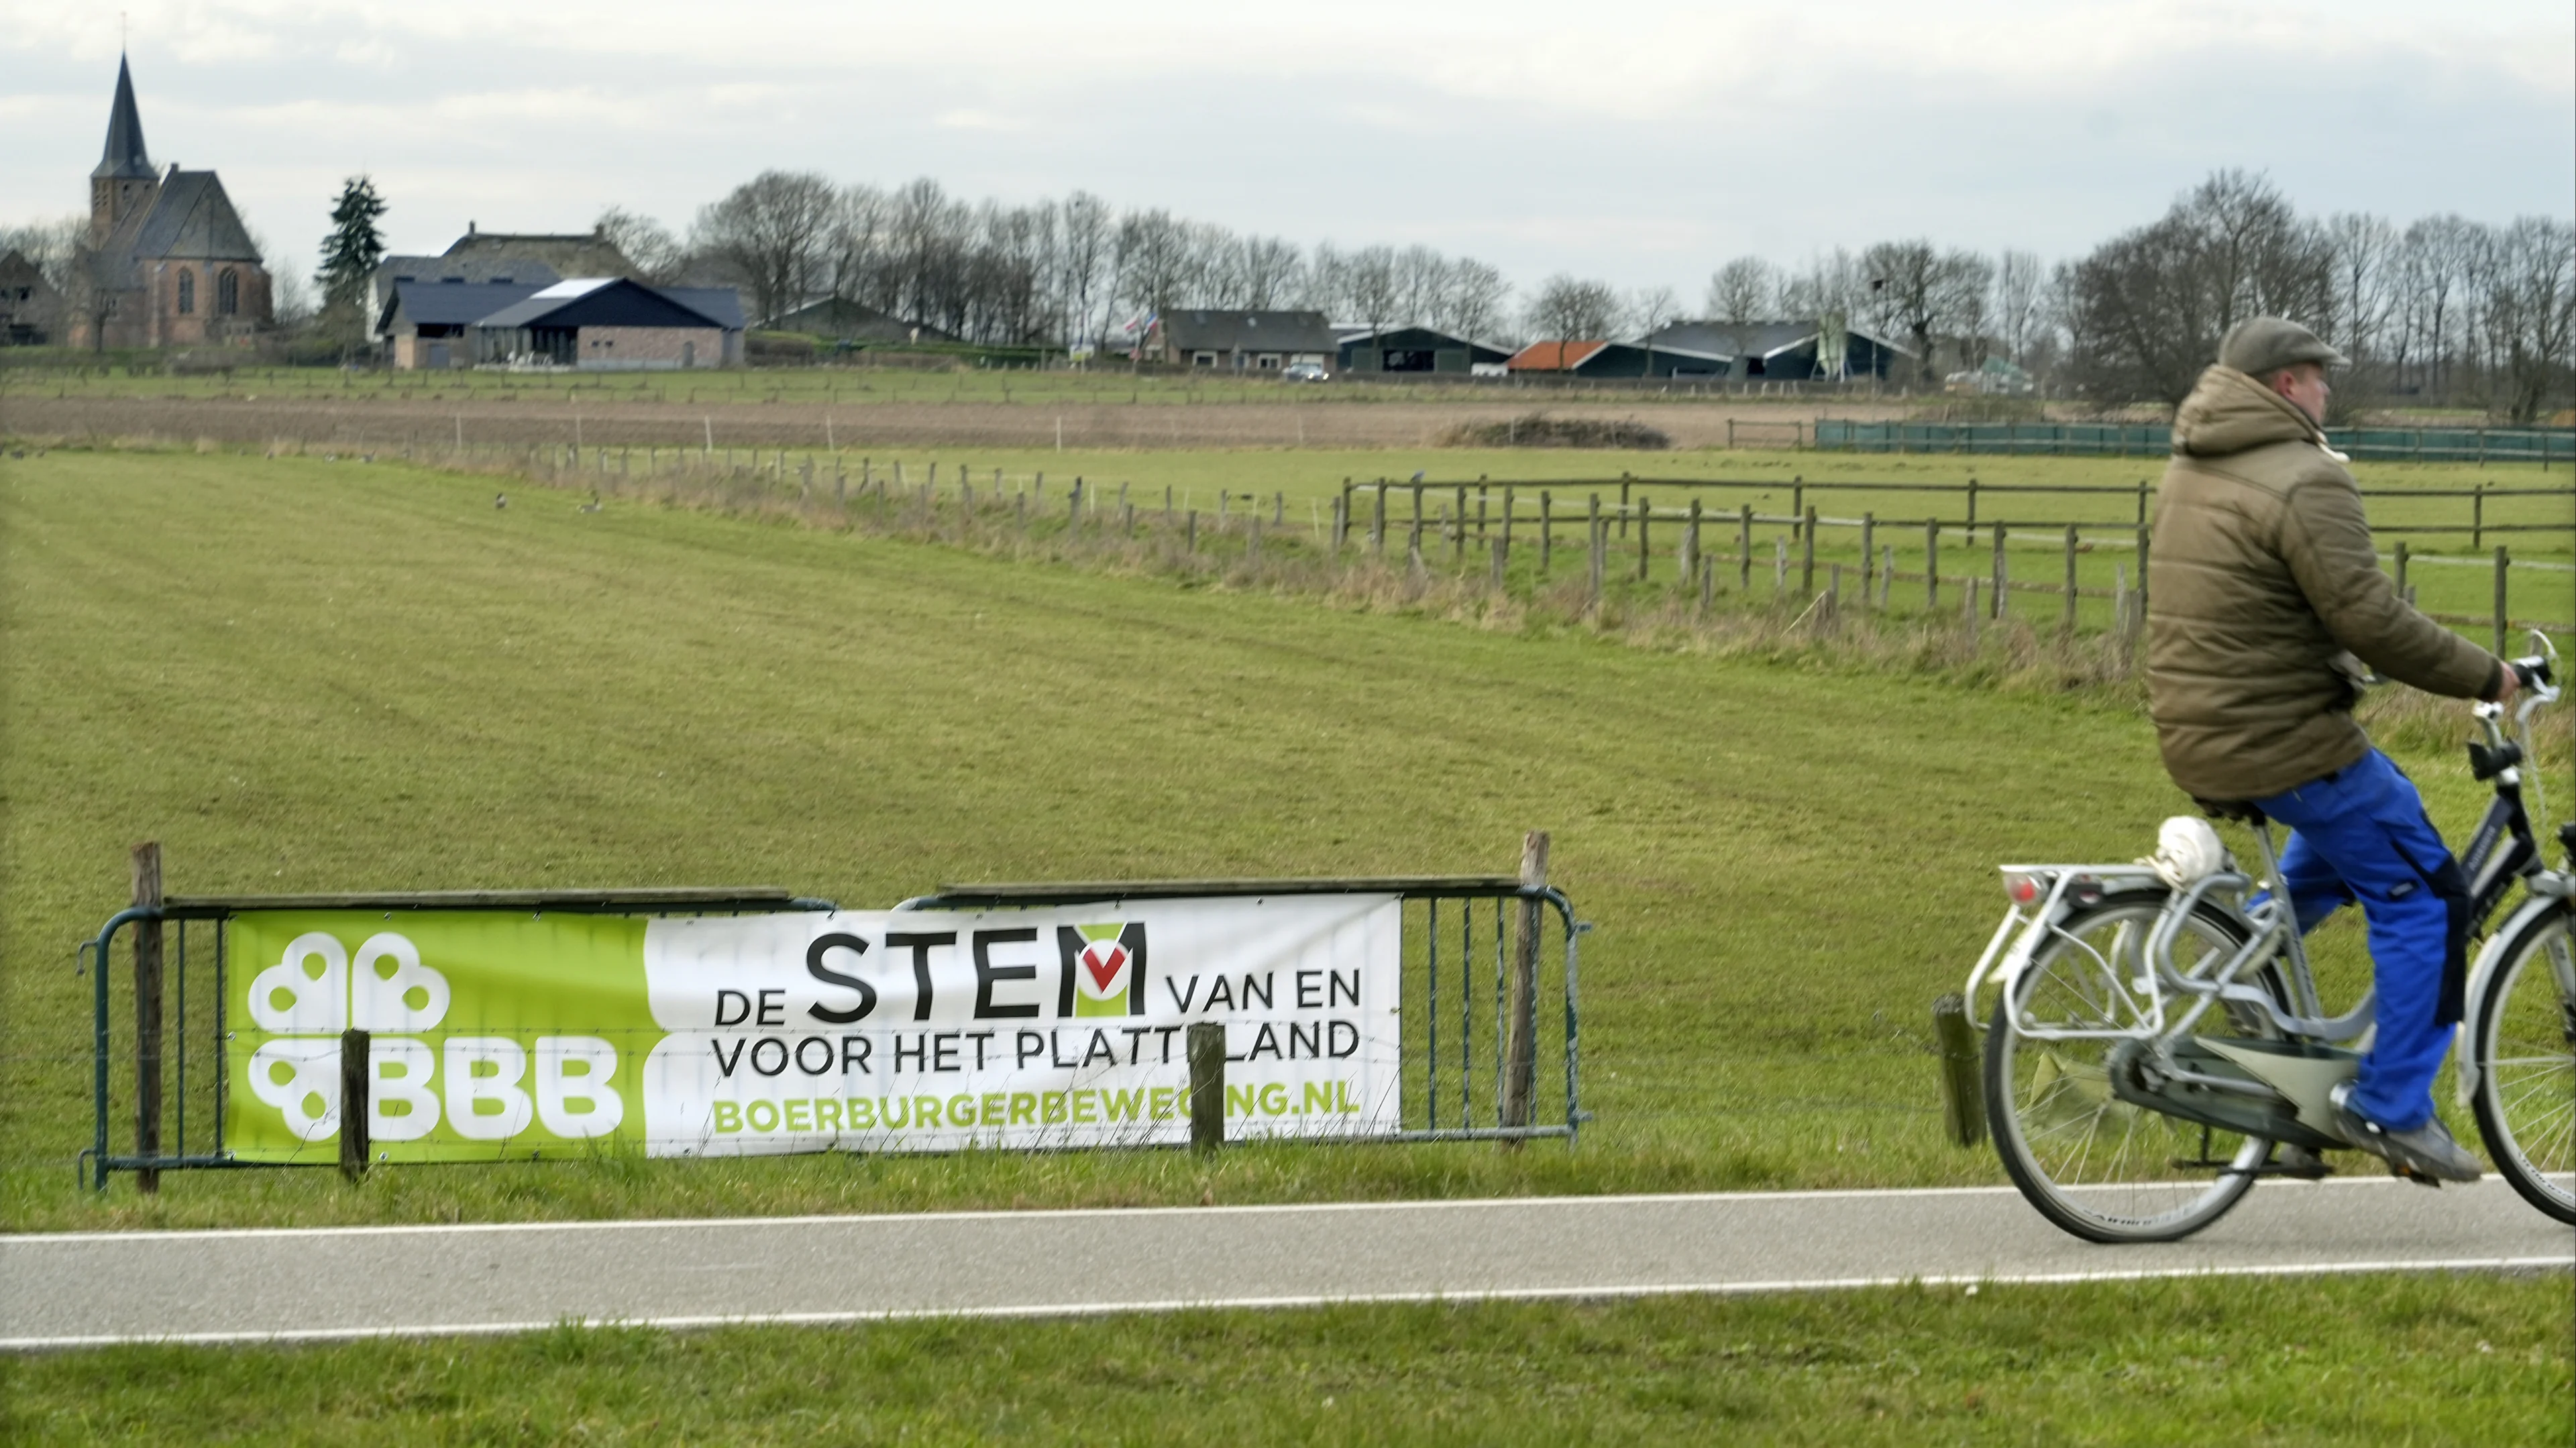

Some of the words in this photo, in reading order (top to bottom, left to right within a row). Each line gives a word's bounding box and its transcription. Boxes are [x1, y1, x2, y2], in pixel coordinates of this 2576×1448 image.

[714, 989, 786, 1026] DE
[806, 922, 1146, 1023] STEM
[1166, 971, 1274, 1013] VAN
[1296, 968, 1360, 1009] EN
[366, 1036, 624, 1141] BBB
[712, 1037, 872, 1077] VOOR
[894, 1033, 994, 1074] HET
[1016, 1020, 1360, 1070] PLATTAND
[714, 1080, 1360, 1134] BOERBURGERBEWENG.NL
